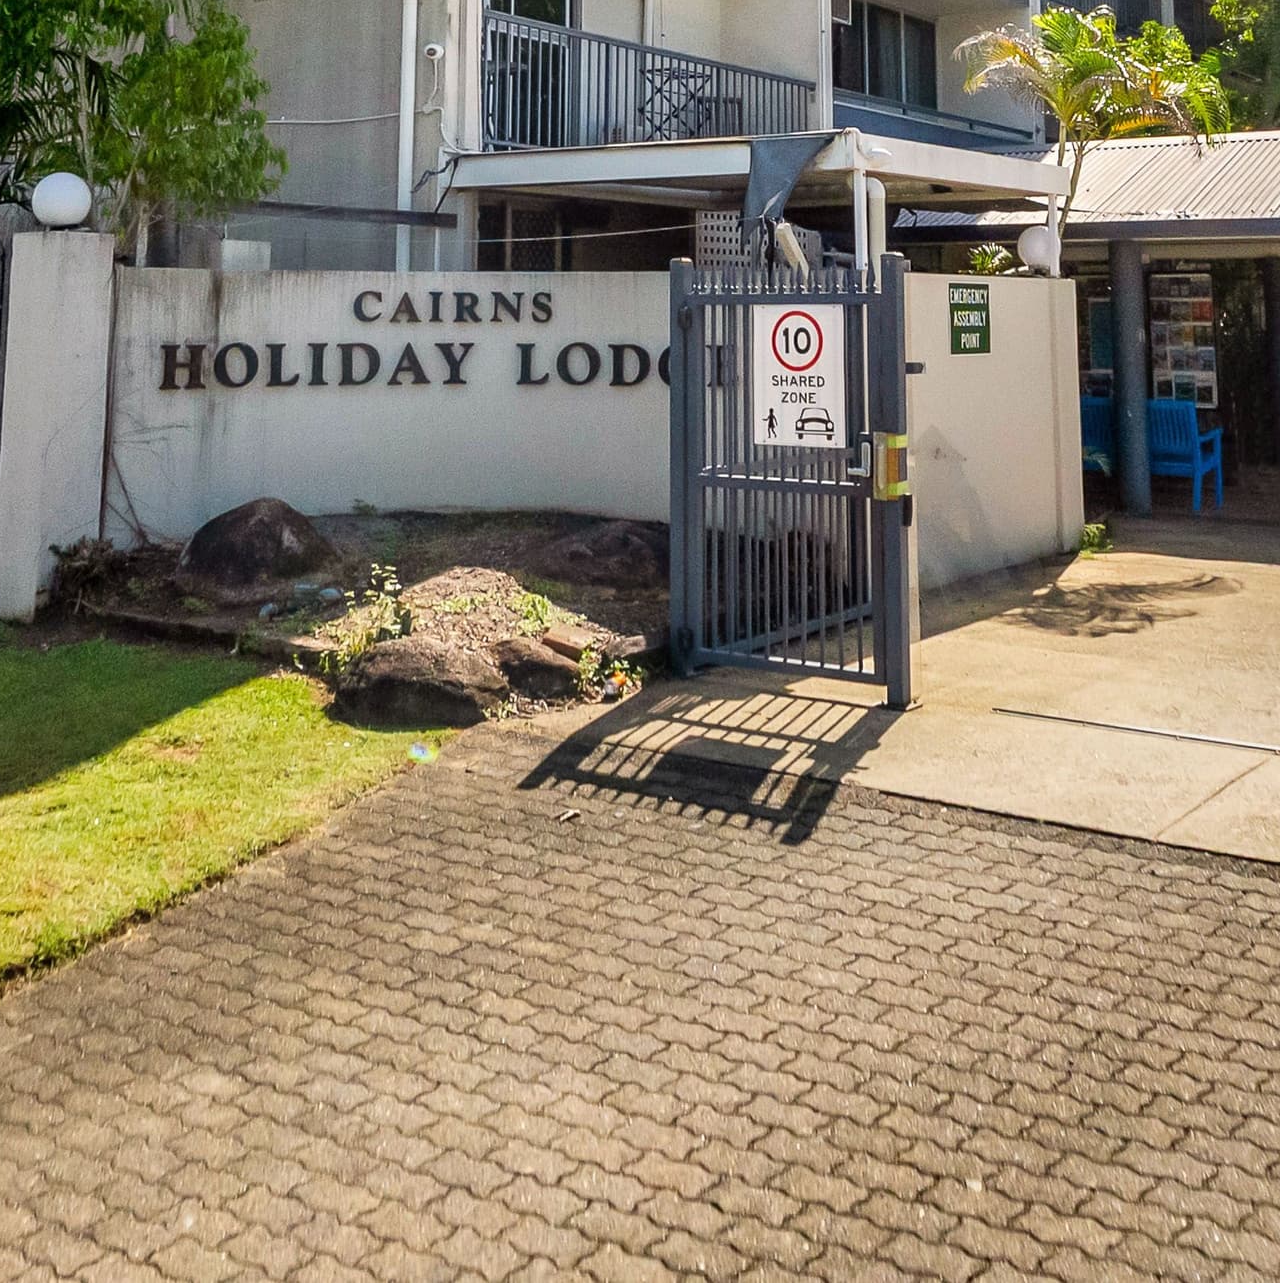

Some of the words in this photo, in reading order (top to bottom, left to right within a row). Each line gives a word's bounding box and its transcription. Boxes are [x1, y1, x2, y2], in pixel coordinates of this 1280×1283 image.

[950, 288, 987, 304] EMERGENCY
[353, 289, 554, 323] CAIRNS
[953, 310, 986, 326] ASSEMBLY
[782, 327, 811, 354] 10
[961, 333, 980, 349] POINT
[159, 341, 474, 390] HOLIDAY
[516, 341, 738, 388] LOD
[771, 374, 825, 388] SHARED
[781, 391, 817, 404] ZONE
